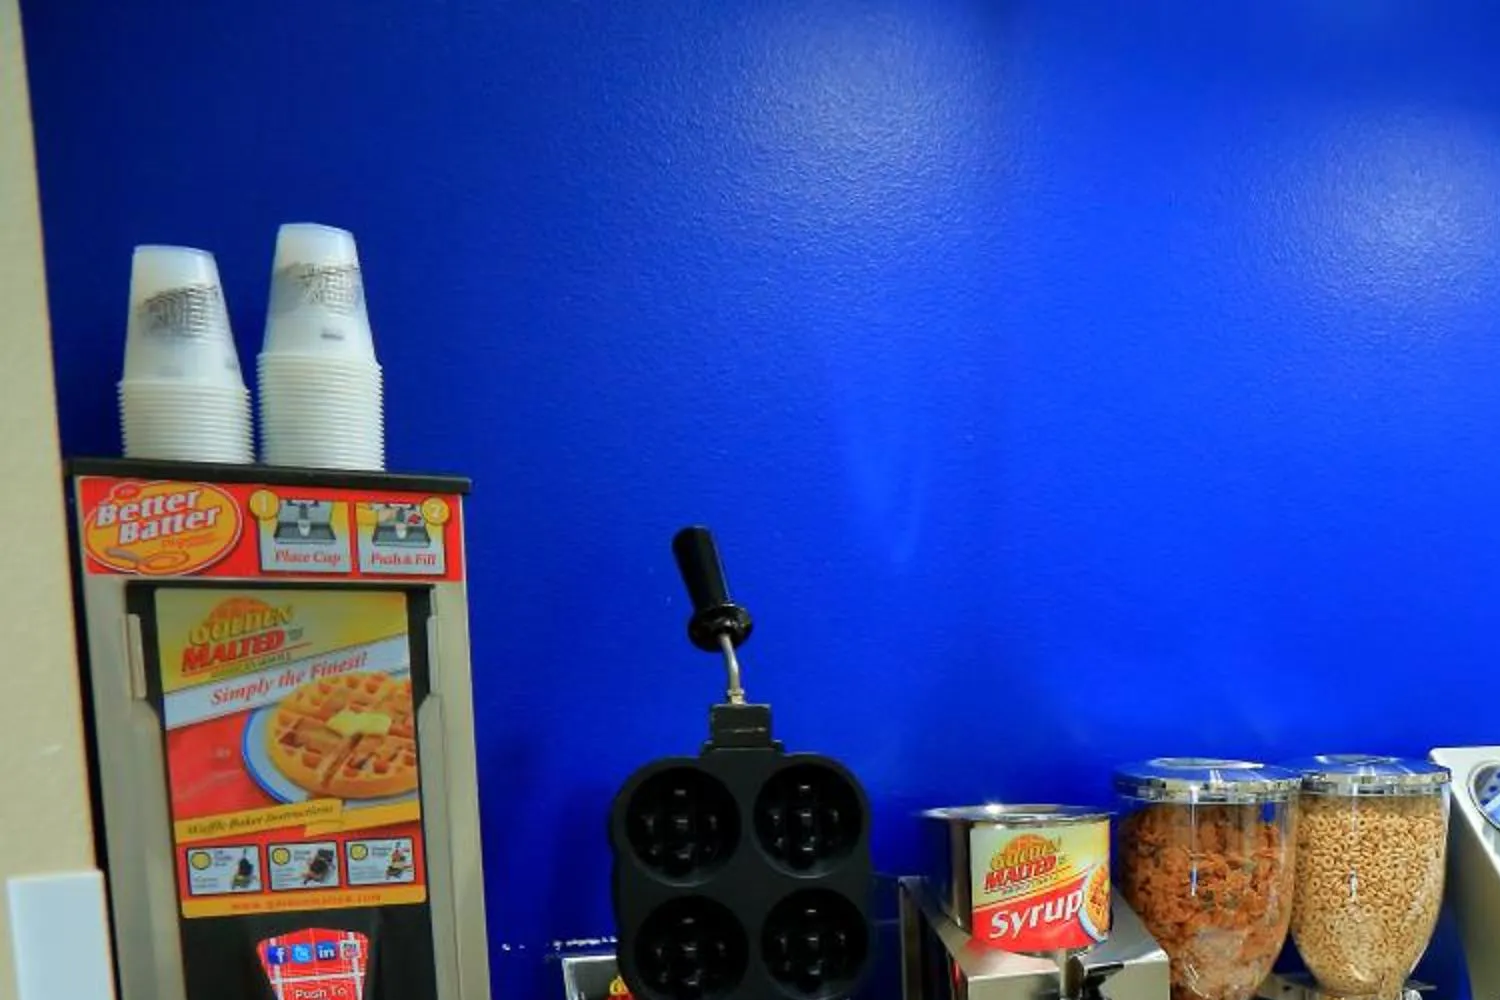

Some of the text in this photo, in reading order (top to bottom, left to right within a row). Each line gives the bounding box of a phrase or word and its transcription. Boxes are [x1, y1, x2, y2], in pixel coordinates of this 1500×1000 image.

[97, 489, 202, 527] Better
[119, 507, 220, 545] Batter
[275, 550, 341, 567] Place Cup
[182, 629, 285, 672] MALTED
[211, 677, 272, 705] Simply
[278, 665, 306, 687] the
[989, 889, 1083, 939] Syrup
